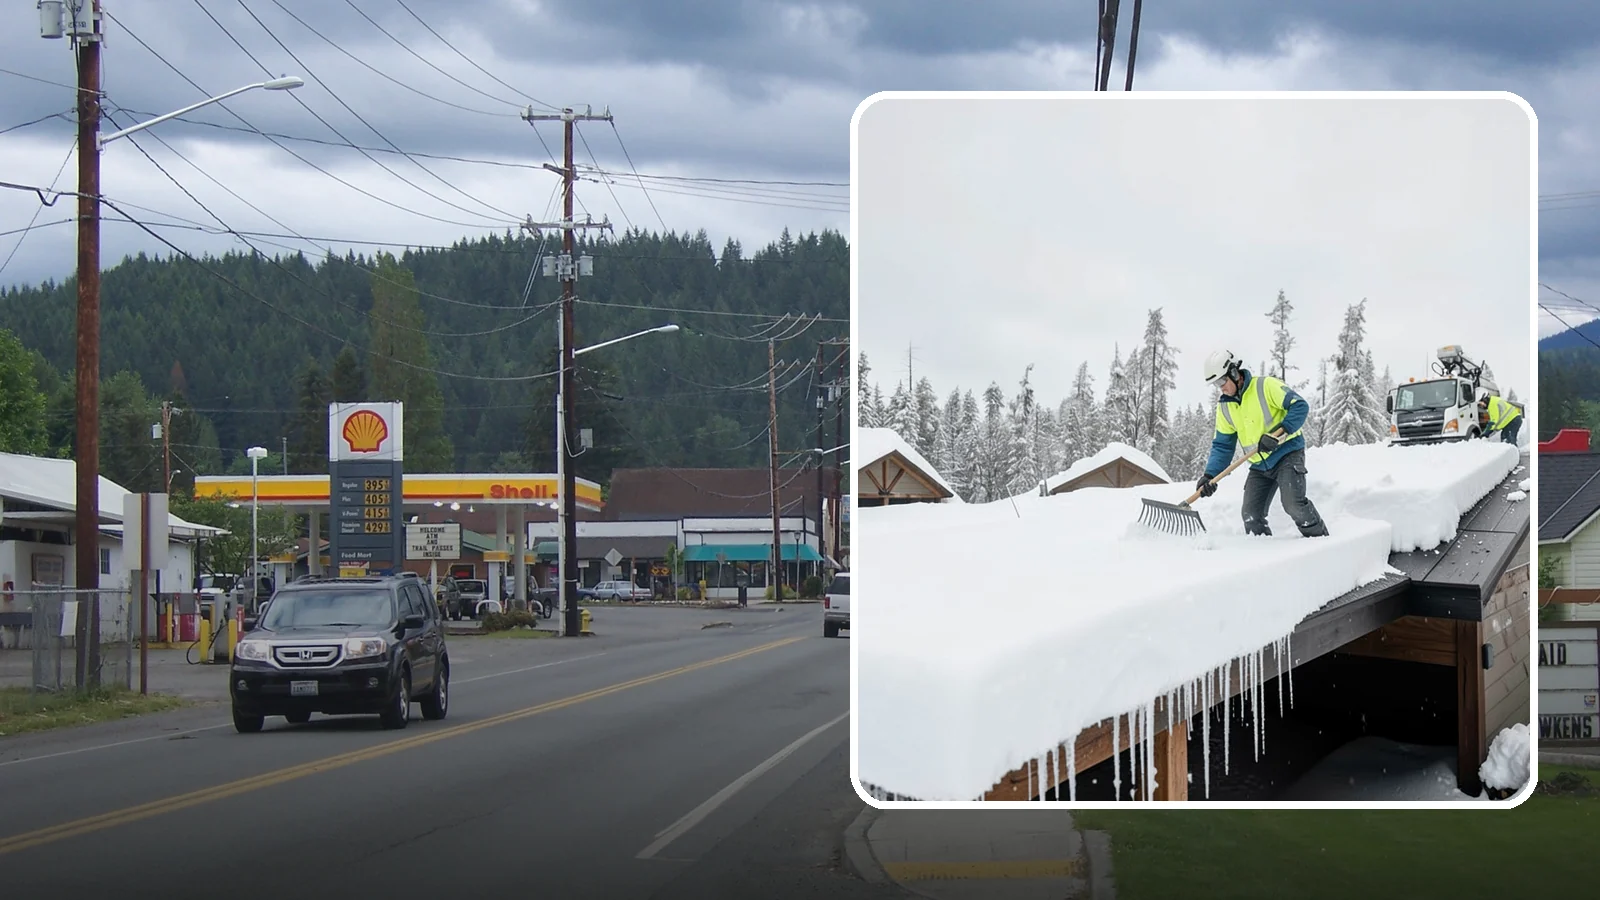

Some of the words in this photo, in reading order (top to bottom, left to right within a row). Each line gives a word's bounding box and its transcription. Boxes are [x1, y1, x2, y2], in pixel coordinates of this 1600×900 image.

[366, 480, 383, 490] 395
[490, 484, 547, 499] Shell
[366, 494, 383, 504] 405
[366, 508, 383, 518] 415
[366, 522, 383, 533] 429
[1538, 643, 1567, 666] AID
